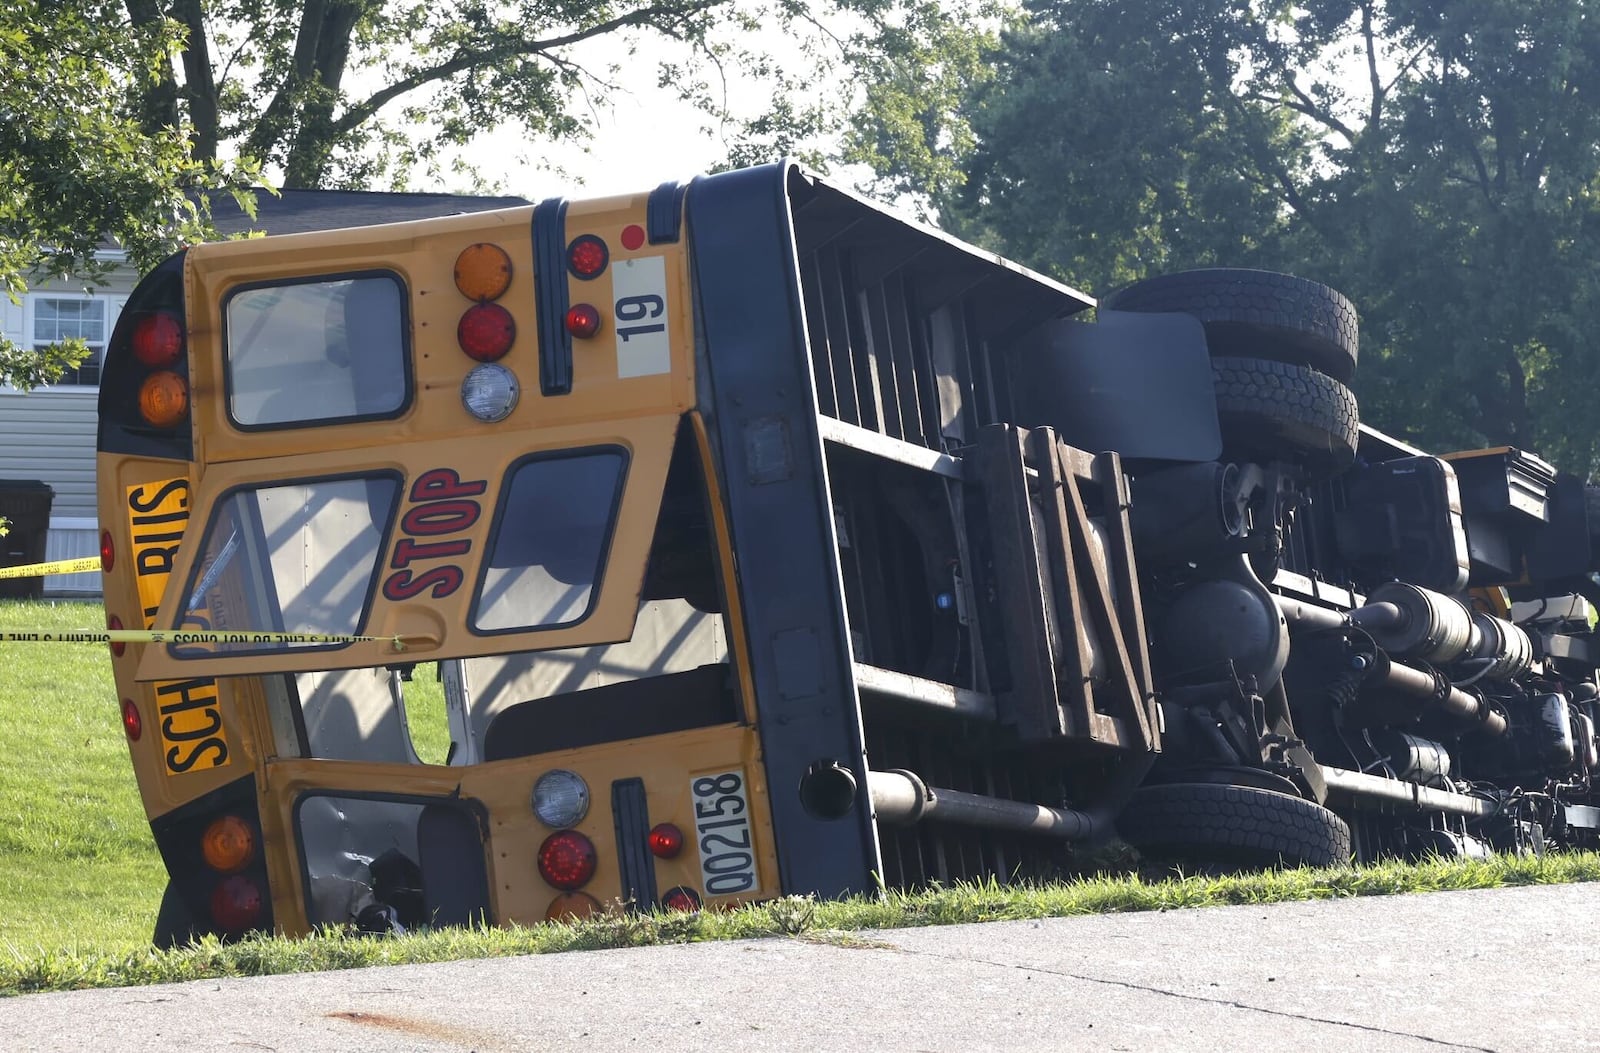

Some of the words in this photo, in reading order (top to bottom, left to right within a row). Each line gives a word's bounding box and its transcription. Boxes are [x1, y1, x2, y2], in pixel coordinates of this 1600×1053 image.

[615, 294, 665, 343] 19
[382, 467, 488, 601] STOP
[693, 773, 754, 895] Q02158
